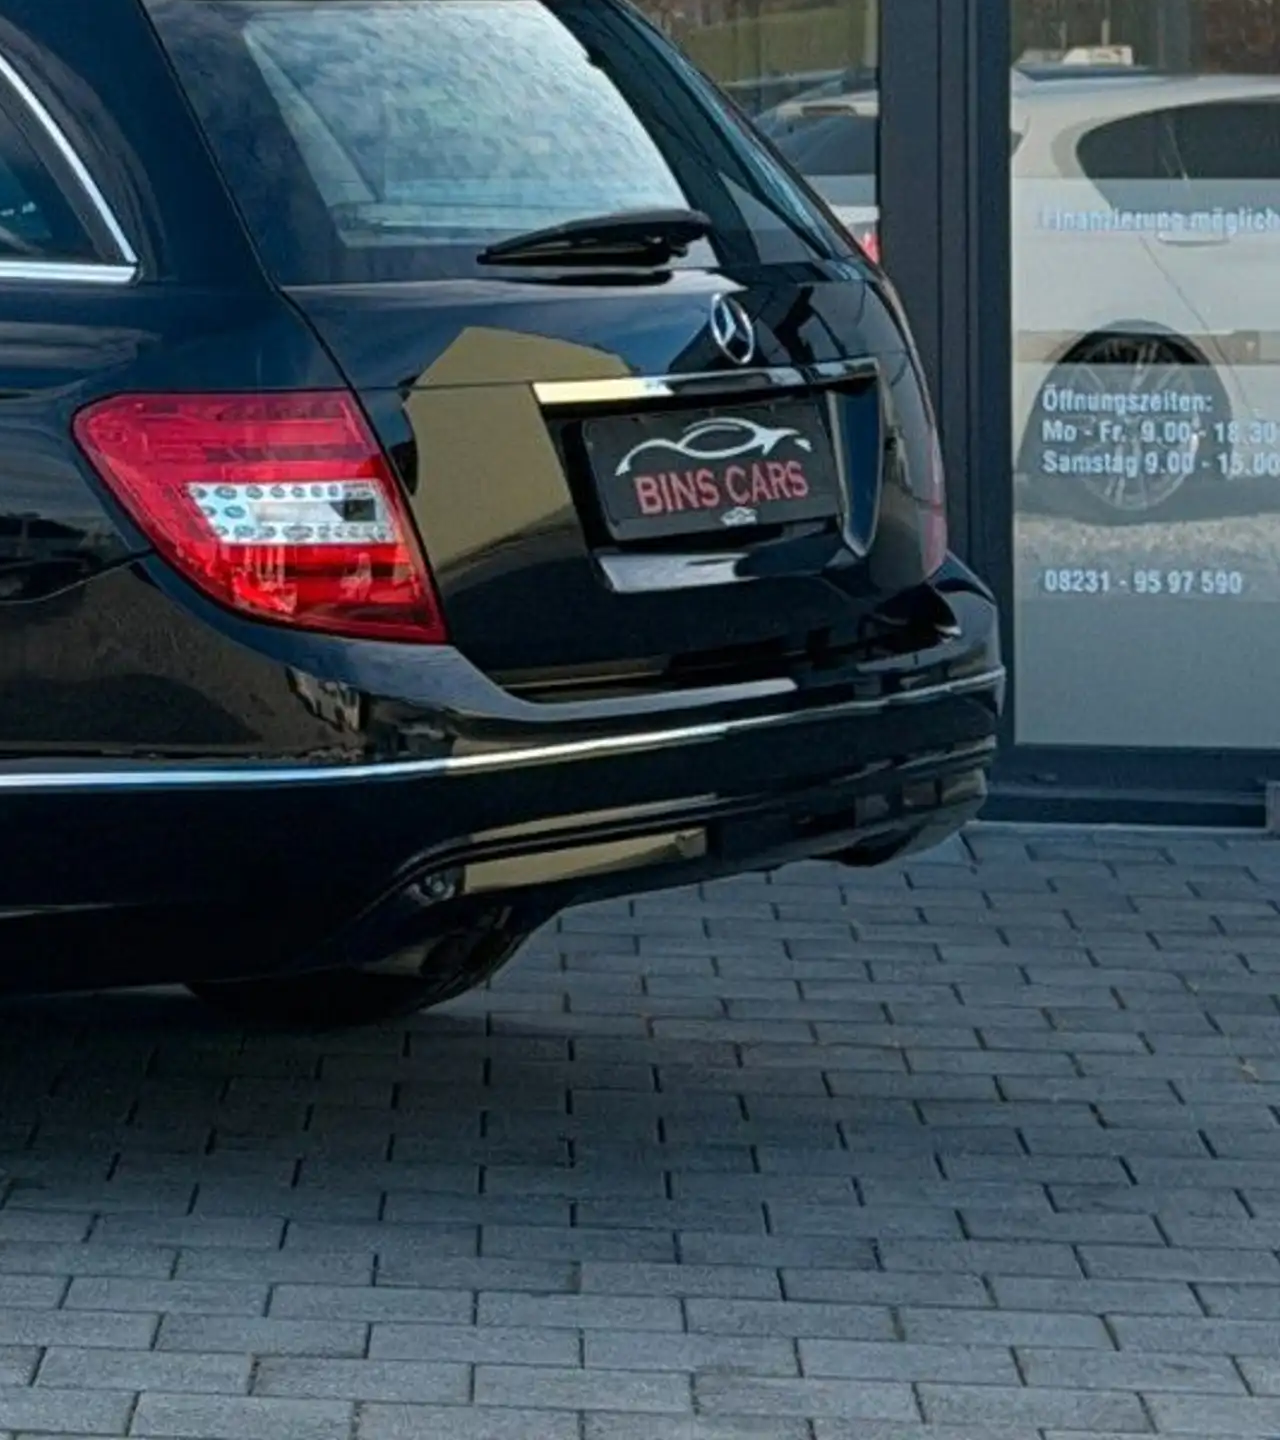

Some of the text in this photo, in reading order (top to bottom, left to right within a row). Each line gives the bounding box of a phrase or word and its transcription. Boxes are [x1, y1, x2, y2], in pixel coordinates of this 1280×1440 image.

[1042, 384, 1213, 415] Öffnungszeiten:
[1042, 420, 1077, 442] Mo
[1099, 420, 1127, 442] Fr.
[1042, 449, 1139, 477] Samstag
[1145, 451, 1195, 474] 9.00
[633, 461, 809, 515] BINS CARS
[1044, 569, 1110, 593] 08231
[1134, 570, 1162, 594] 95
[1167, 570, 1194, 594] 97
[1201, 570, 1243, 595] 590
